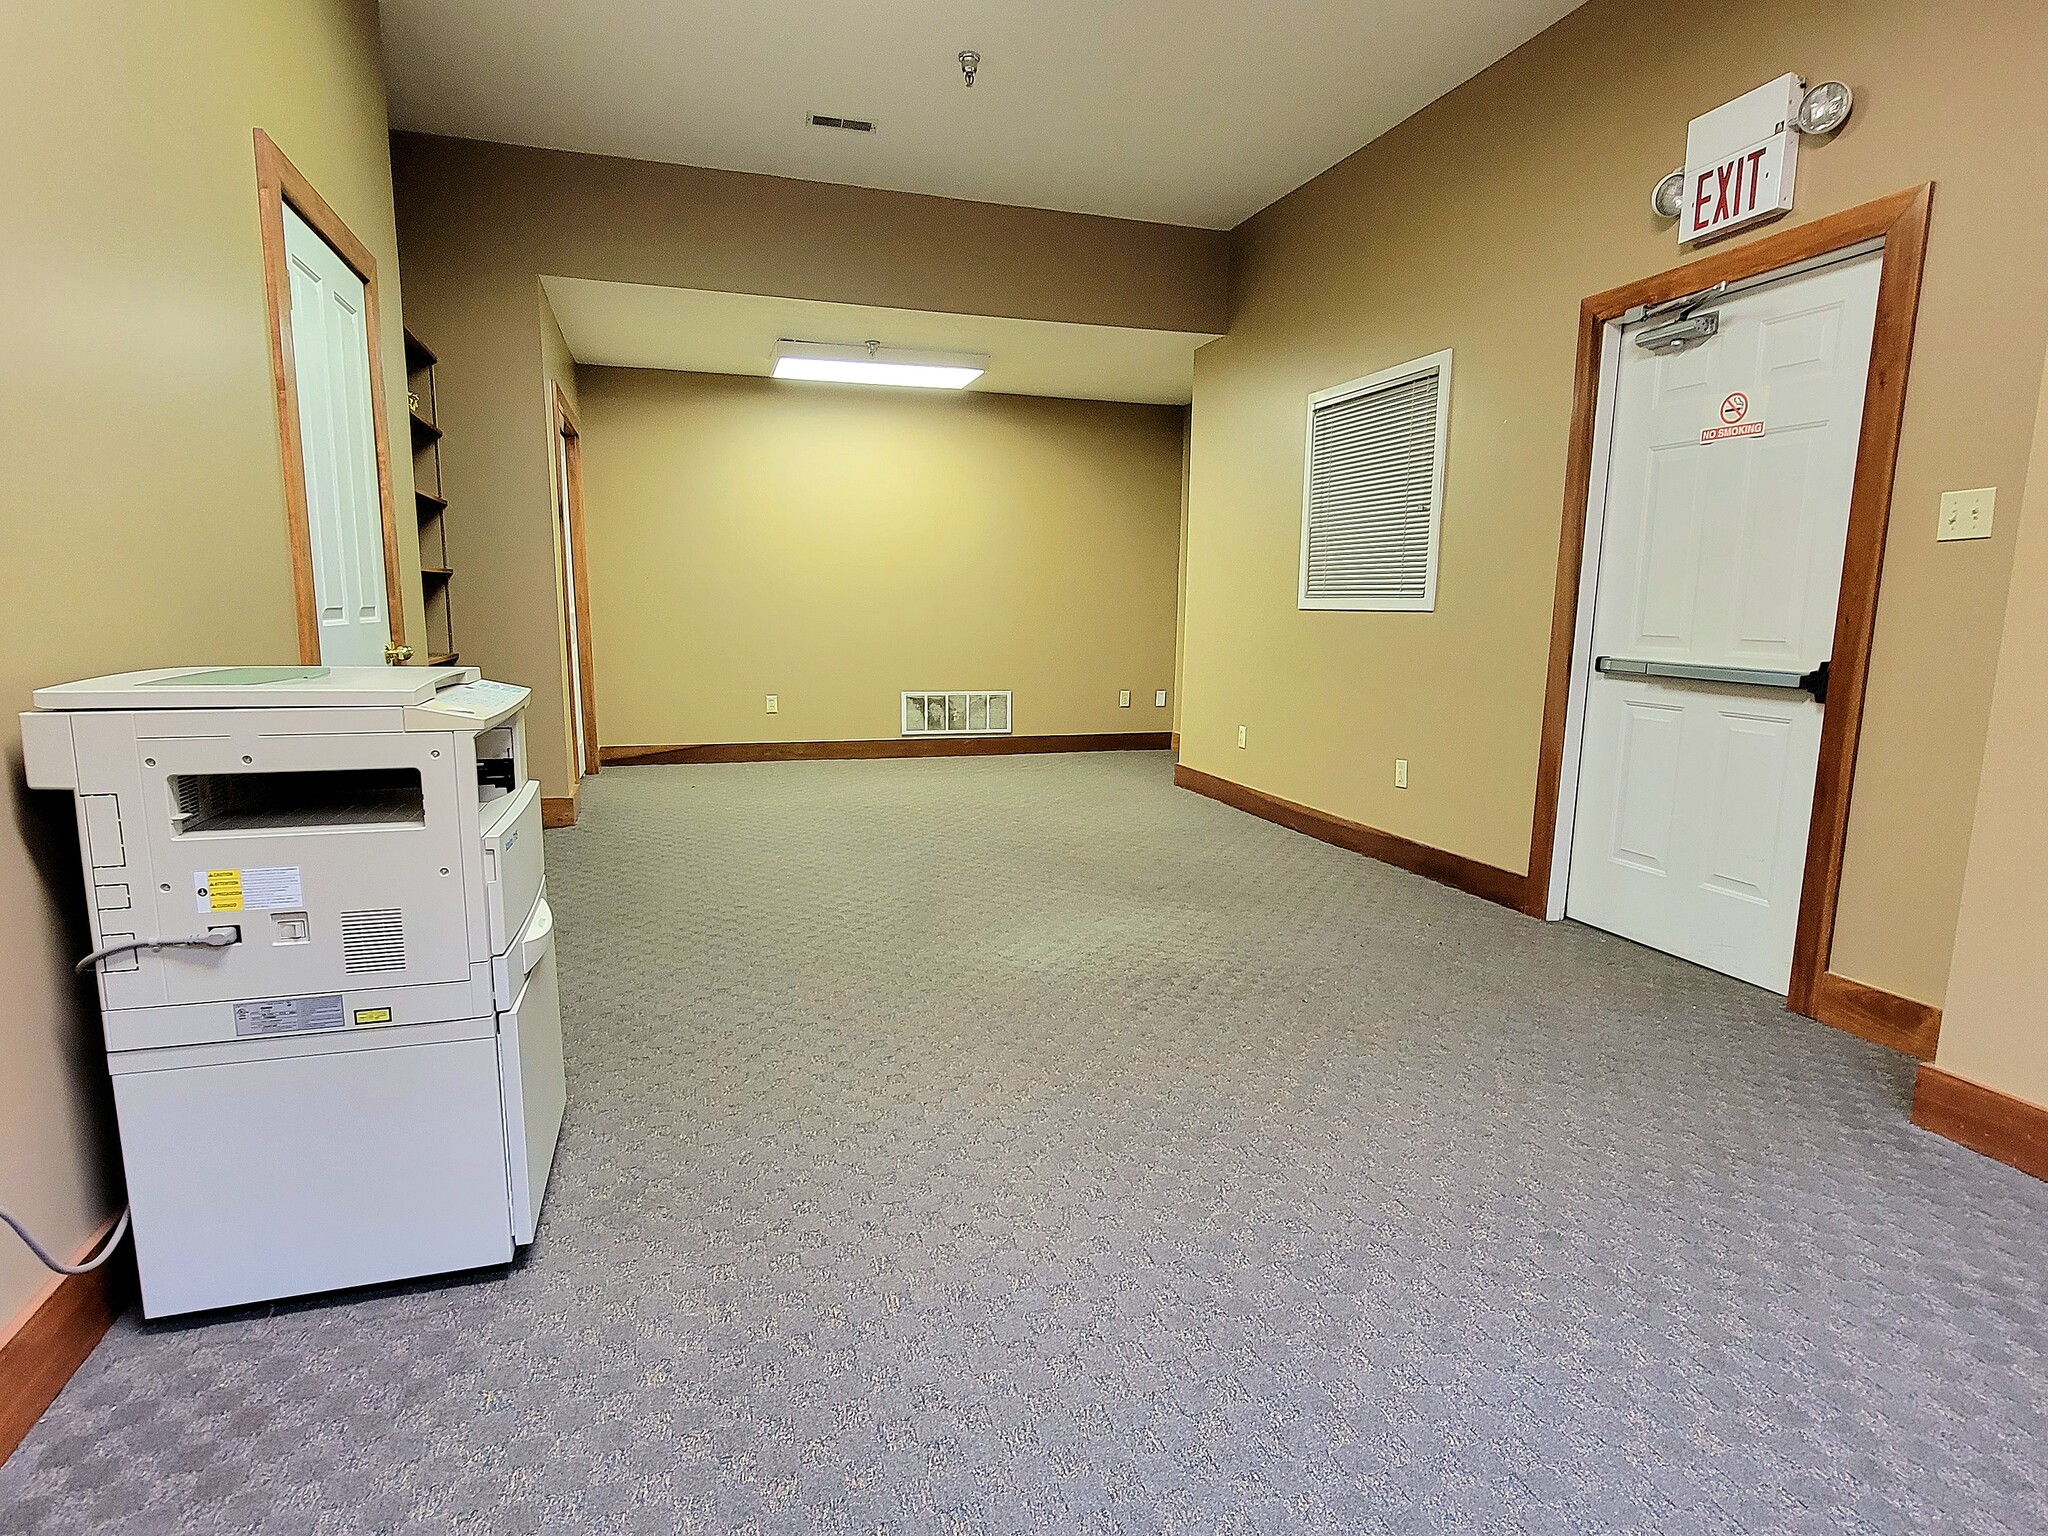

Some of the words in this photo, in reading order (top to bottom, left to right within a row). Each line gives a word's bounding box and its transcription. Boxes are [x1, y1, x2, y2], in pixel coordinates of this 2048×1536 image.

[1693, 147, 1767, 231] EXIT
[1702, 430, 1716, 440] NO
[1718, 423, 1762, 437] SMOKING
